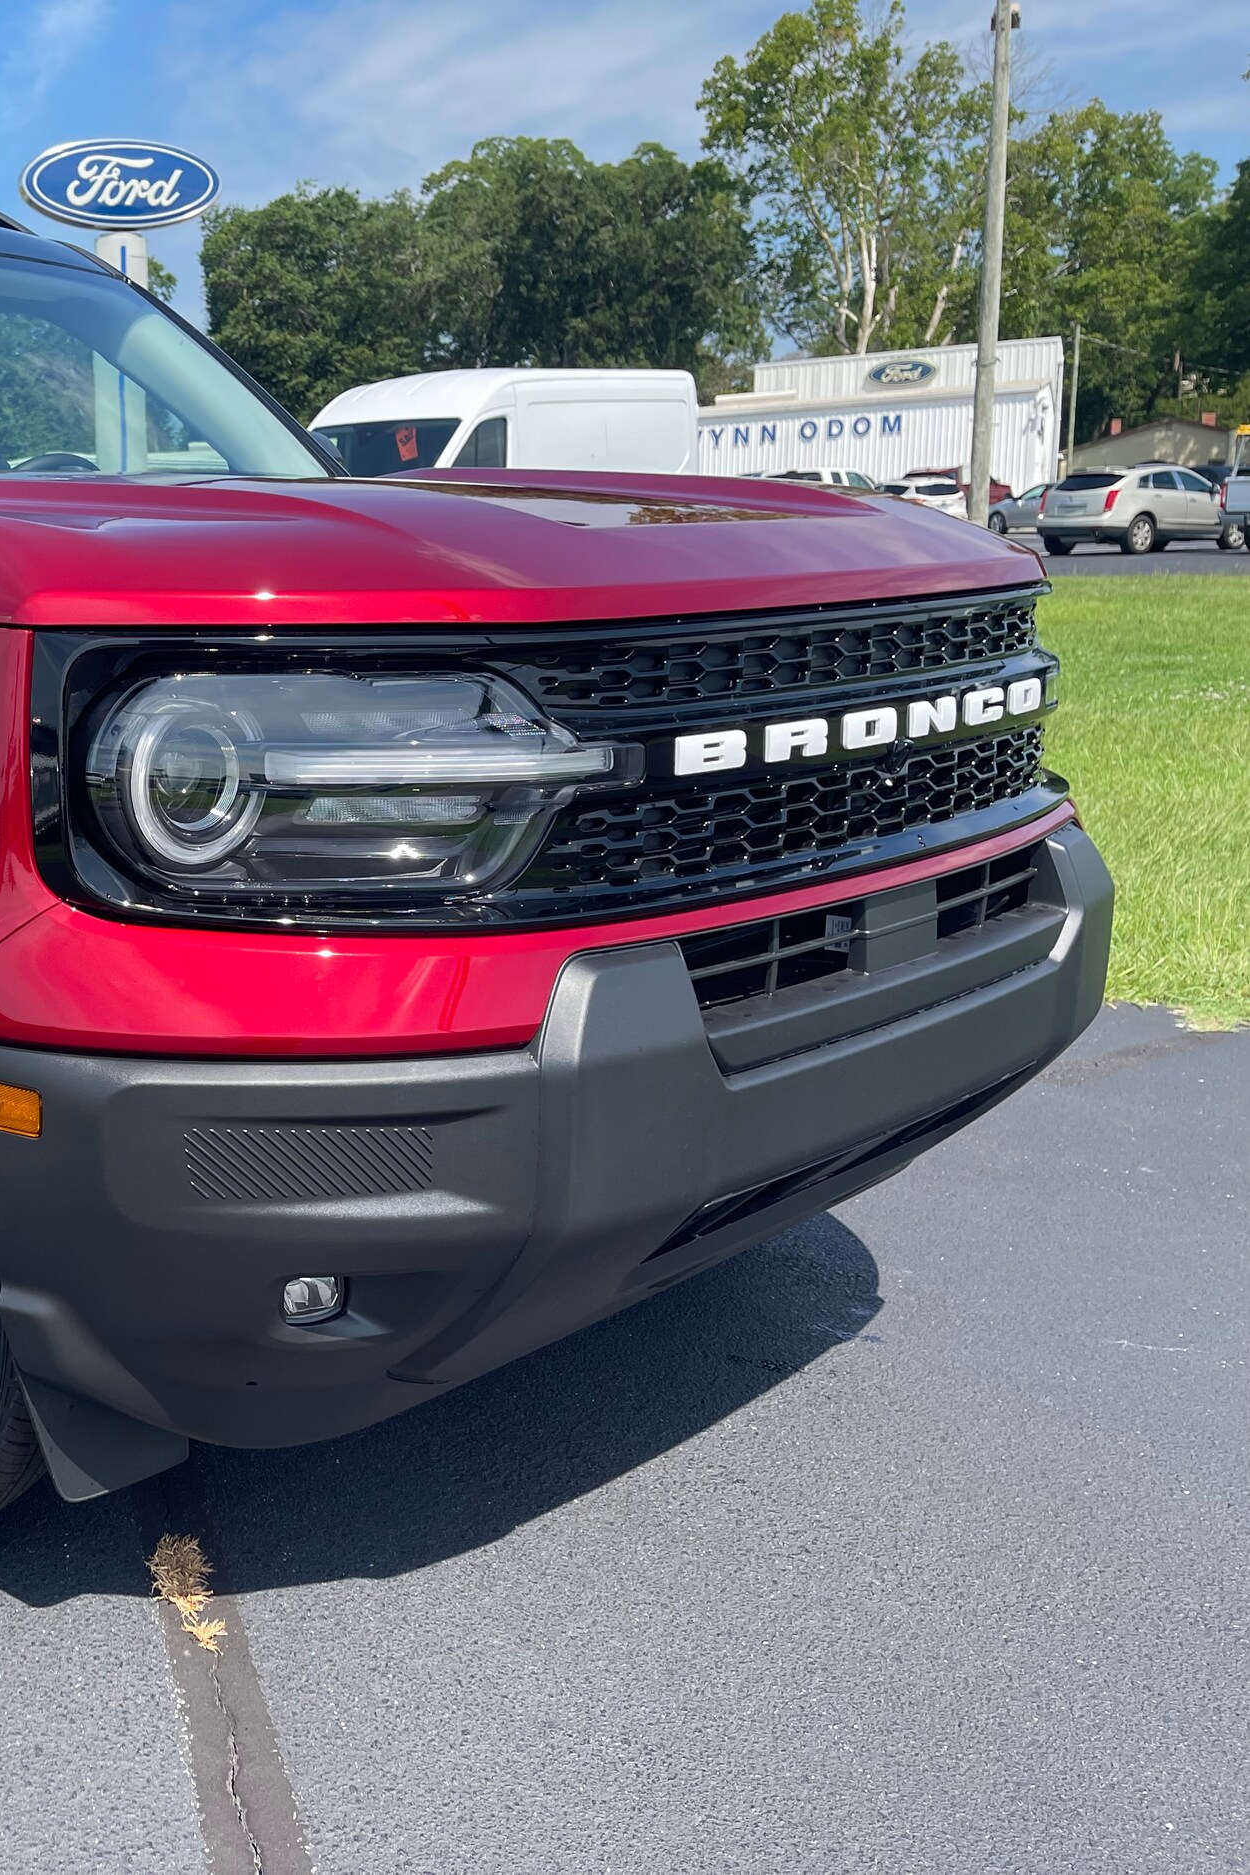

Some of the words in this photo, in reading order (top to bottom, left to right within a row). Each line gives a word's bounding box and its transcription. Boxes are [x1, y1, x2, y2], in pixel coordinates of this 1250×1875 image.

[66, 154, 183, 206] Ford
[880, 363, 923, 383] Ford
[699, 424, 776, 449] YNN
[800, 415, 903, 441] ODOM
[673, 678, 1042, 776] BRONCO
